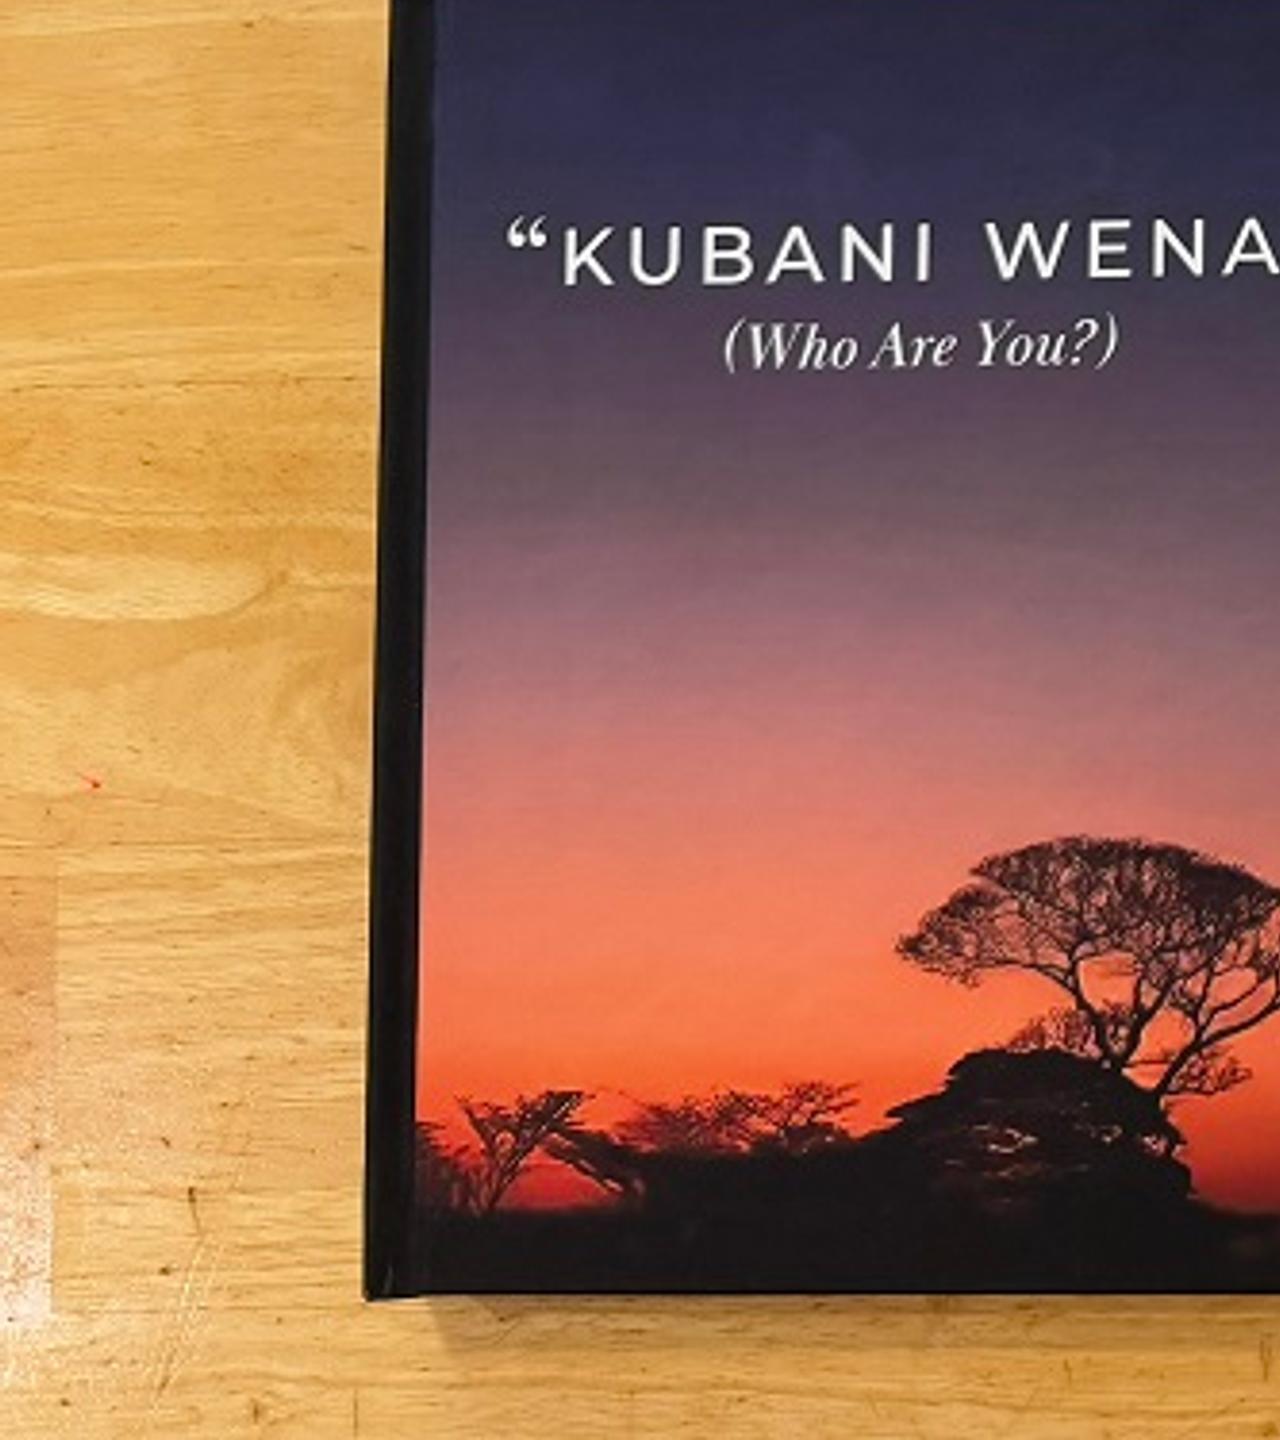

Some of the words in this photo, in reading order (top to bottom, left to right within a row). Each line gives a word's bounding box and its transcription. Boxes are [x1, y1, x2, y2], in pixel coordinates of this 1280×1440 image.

[725, 321, 857, 372] (Who
[871, 323, 957, 367] Are
[979, 317, 1117, 366] You?)
